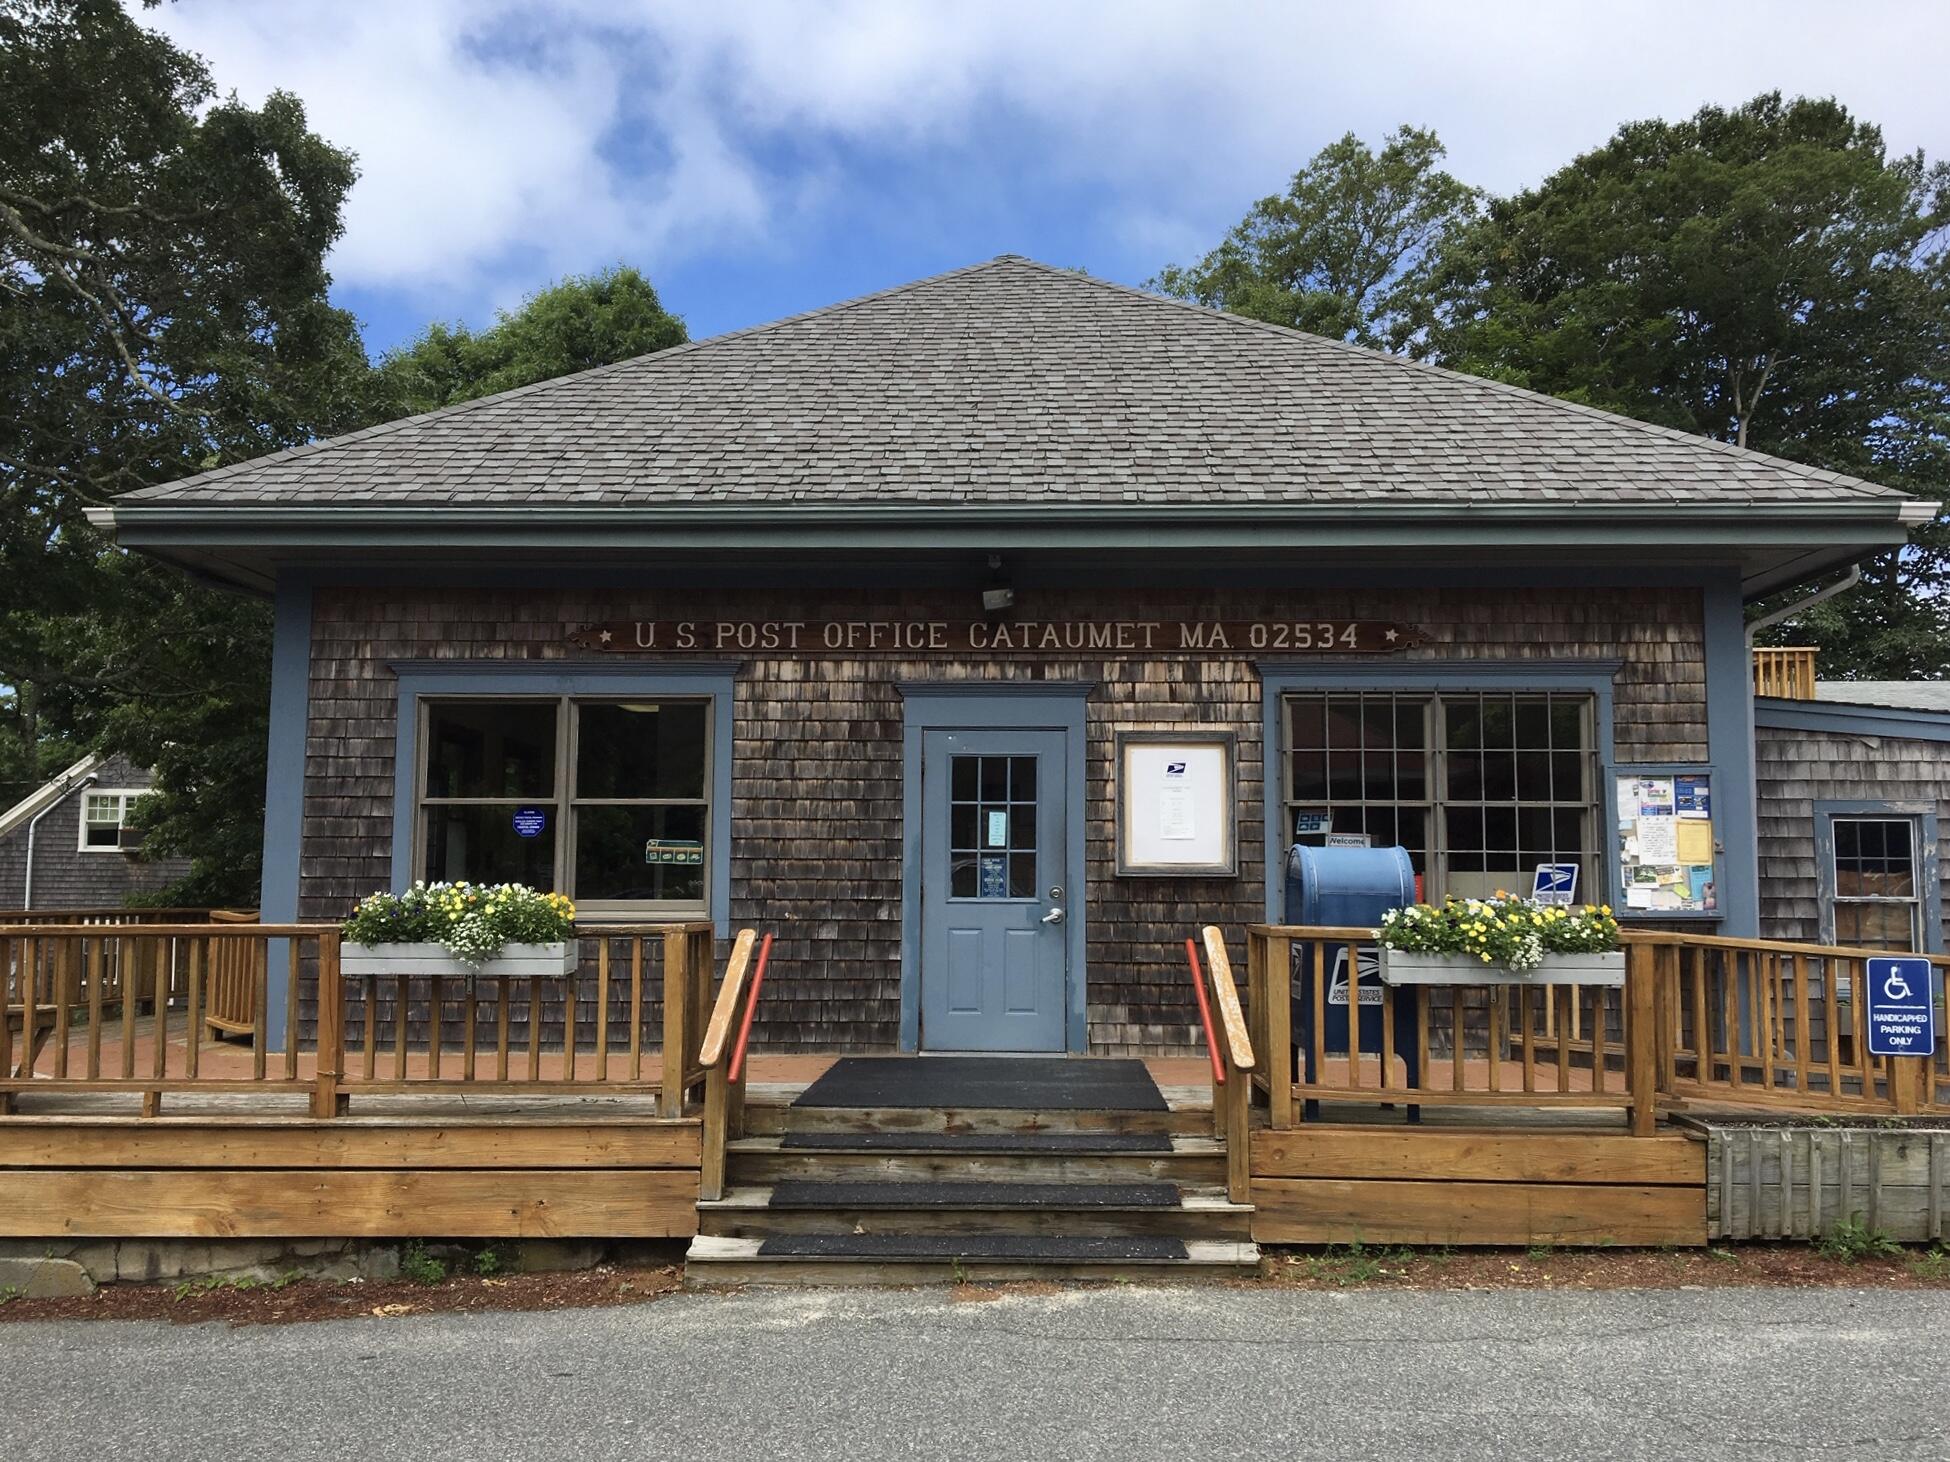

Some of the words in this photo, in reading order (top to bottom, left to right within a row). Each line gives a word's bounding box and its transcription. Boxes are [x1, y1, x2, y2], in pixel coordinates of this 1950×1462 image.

[716, 622, 806, 649] POST
[823, 622, 949, 649] OFFICE
[968, 622, 1161, 649] CATAUMET
[1249, 622, 1358, 649] 02534
[1873, 1013, 1928, 1023] HANDICAPPED
[1880, 1025, 1921, 1034] PARKING
[1889, 1036, 1913, 1045] ONLY
